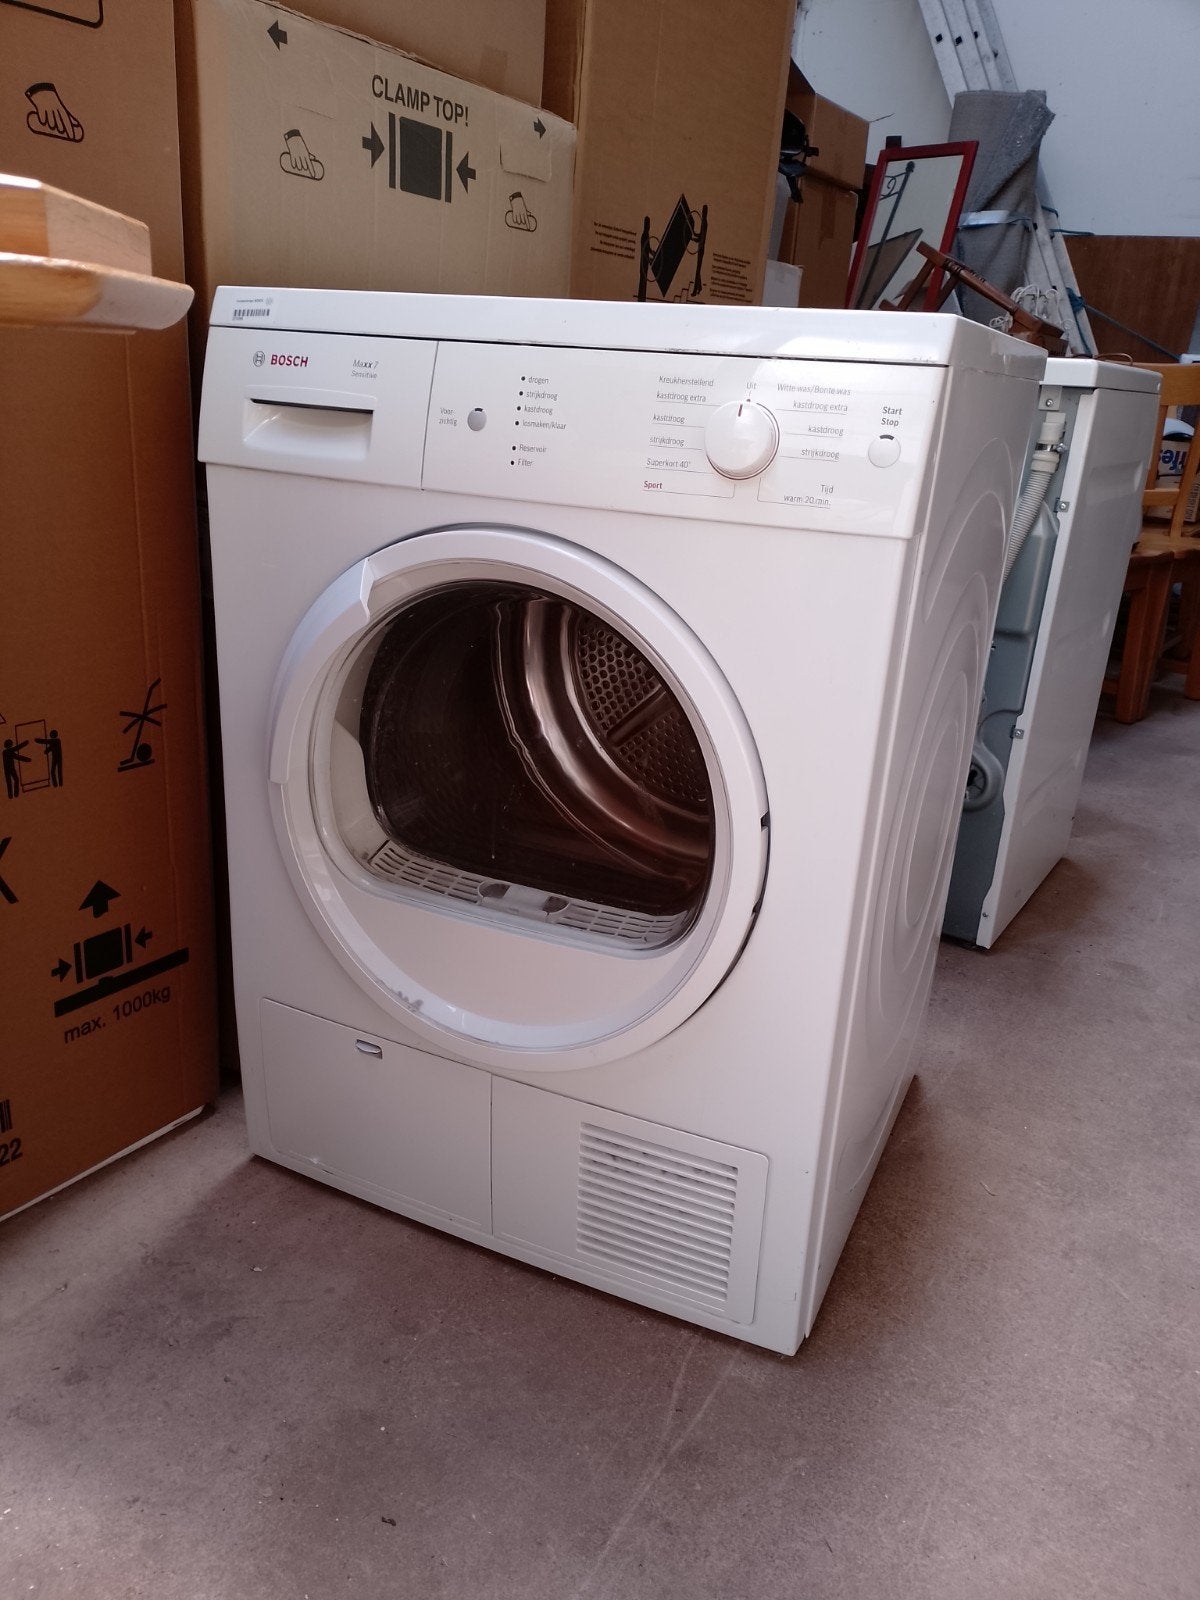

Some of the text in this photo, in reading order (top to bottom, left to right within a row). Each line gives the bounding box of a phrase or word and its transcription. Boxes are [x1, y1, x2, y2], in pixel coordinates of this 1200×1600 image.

[372, 74, 469, 127] CLAMP TOP!
[270, 354, 309, 368] BOSCH
[352, 360, 372, 369] Maxx
[351, 370, 378, 379] Sensitive
[528, 376, 549, 385] drogen
[658, 376, 714, 388] Kreukherstellend
[746, 382, 756, 390] Uit
[777, 384, 796, 393] Witte
[526, 390, 558, 401] strijkdroog
[656, 390, 706, 402] kastdroog extra
[524, 404, 554, 416] kastdroog
[792, 400, 828, 412] kastdroog
[882, 406, 902, 416] Start
[652, 413, 686, 424] kastdroog
[880, 417, 900, 427] Stop
[808, 424, 844, 436] kastdroog
[650, 436, 685, 447] strijkdroog
[519, 444, 547, 453] Reservoir
[801, 448, 840, 460] strijkdroog
[518, 458, 534, 467] Filter
[646, 458, 679, 468] Superkort
[644, 480, 662, 490] Sport
[820, 484, 834, 495] Tijd
[784, 494, 803, 504] warm
[64, 985, 172, 1044] max. 1000kg
